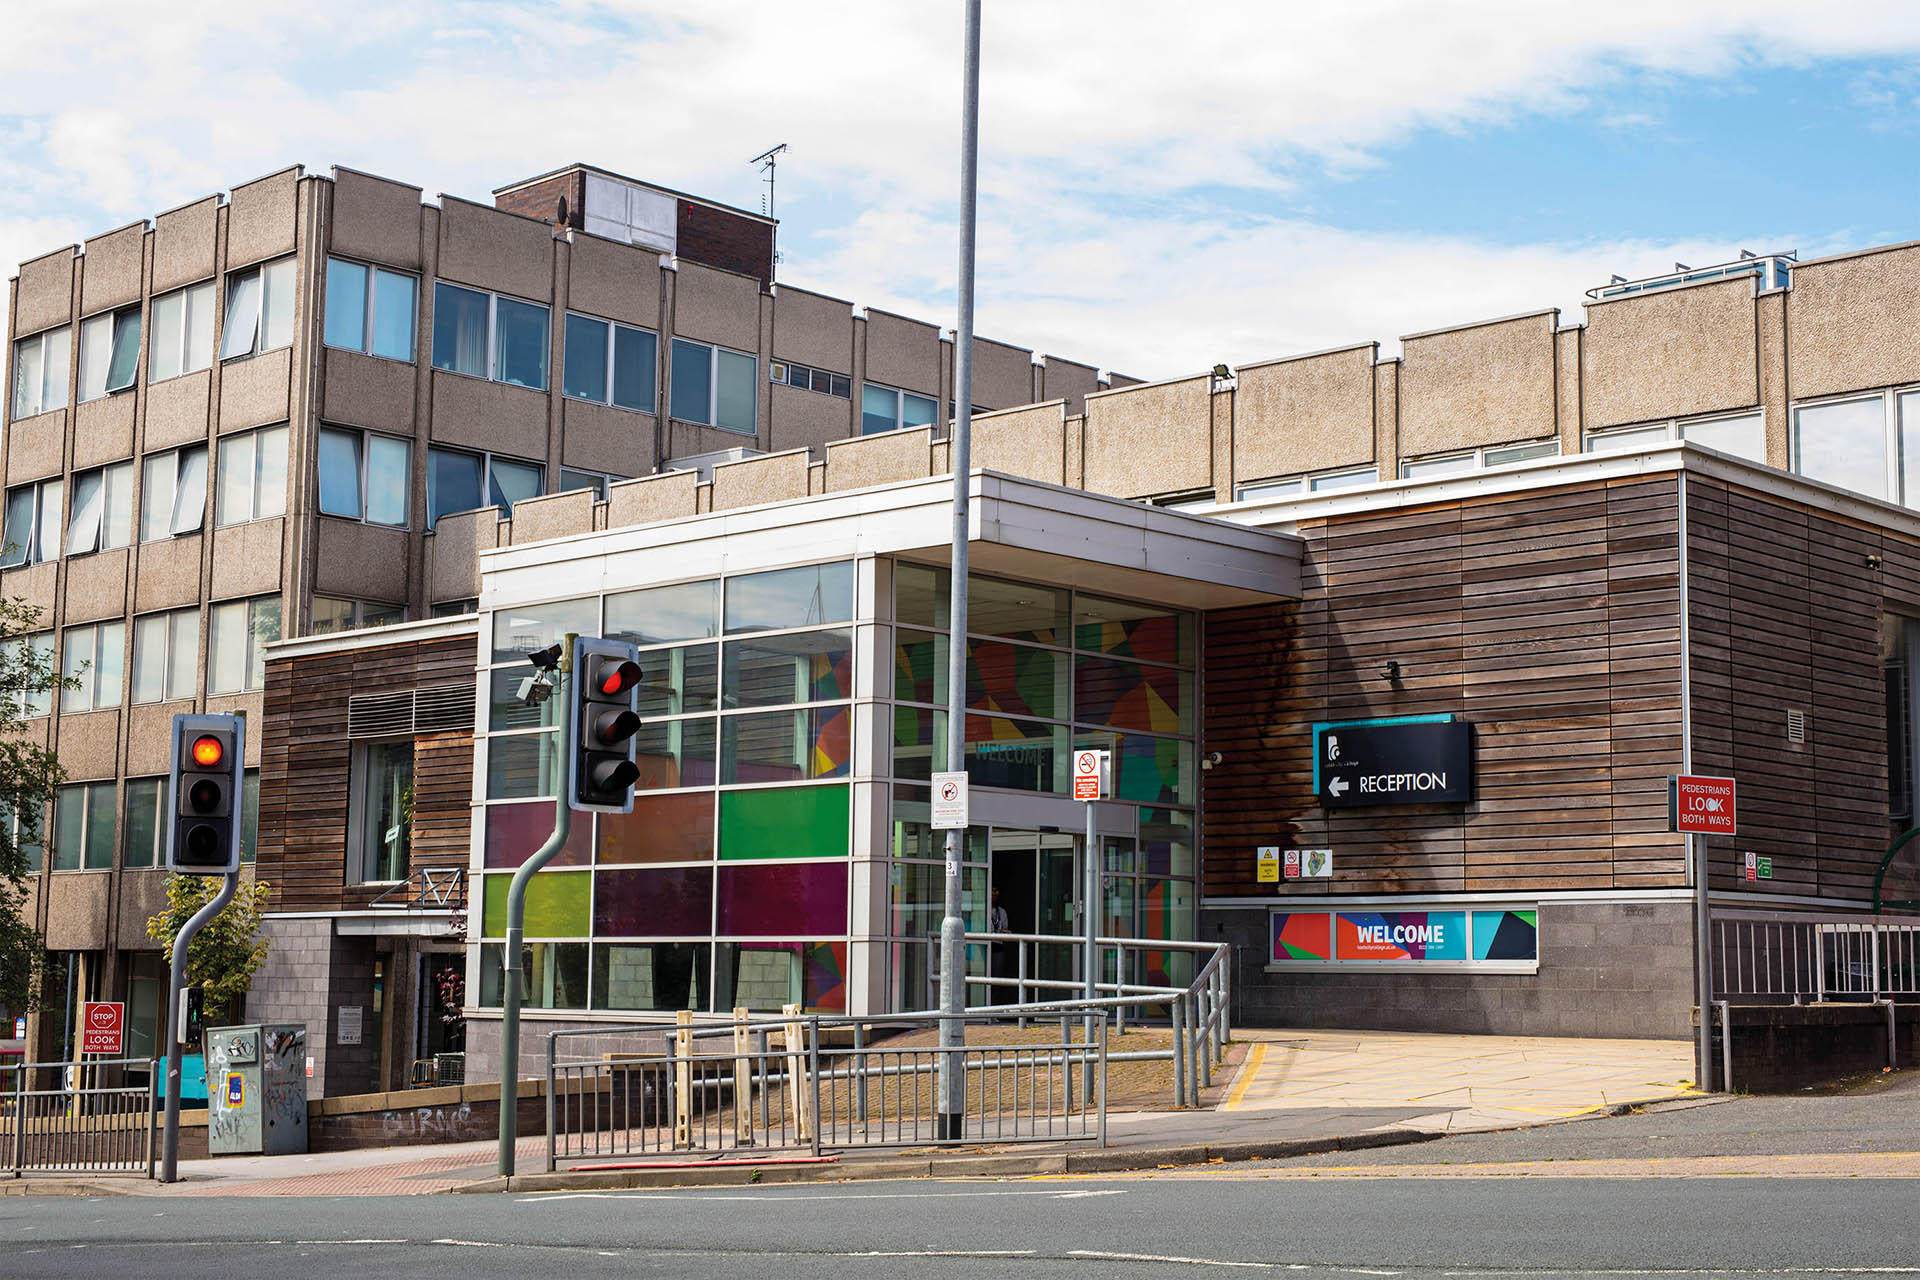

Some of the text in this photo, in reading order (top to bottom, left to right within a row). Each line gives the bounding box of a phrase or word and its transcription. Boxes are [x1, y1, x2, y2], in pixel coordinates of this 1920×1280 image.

[1359, 772, 1446, 793] RECEPTION
[1681, 783, 1731, 796] PEDESTRIANS
[1688, 796, 1724, 812] LOOK
[1681, 813, 1731, 826] BOTH WAYS
[1357, 925, 1444, 944] WELCOME
[89, 1036, 115, 1044] LOOK
